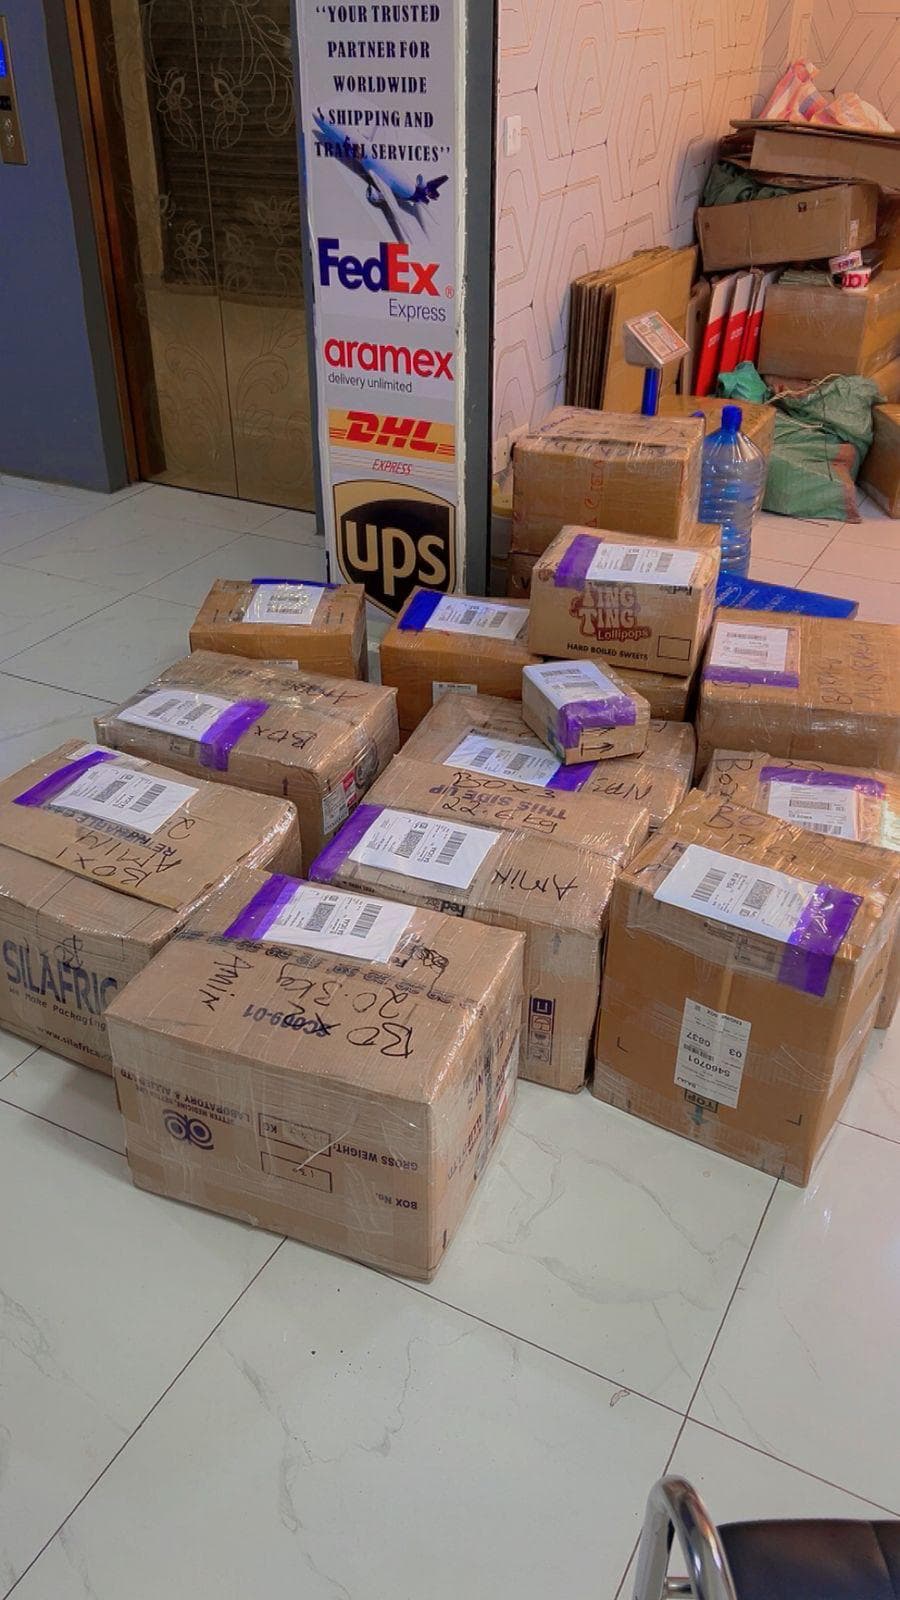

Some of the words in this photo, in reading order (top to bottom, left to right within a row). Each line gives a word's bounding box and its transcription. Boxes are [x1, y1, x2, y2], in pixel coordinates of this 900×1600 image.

[371, 5, 441, 23] TRUSTED
[327, 41, 397, 59] PARTNER
[399, 41, 431, 59] FOR
[333, 75, 428, 94] WORLDWIDE
[328, 109, 401, 128] SHIPPING
[404, 110, 434, 129] AND
[314, 140, 368, 159] TRAVEL
[317, 237, 441, 297] FedEx
[389, 298, 447, 323] Express
[324, 338, 454, 381] aramex
[328, 371, 366, 389] delivery
[367, 378, 413, 393] unlimited
[346, 411, 438, 453] DHL
[372, 458, 413, 476] EXPRESS
[346, 520, 447, 596] ups
[578, 607, 637, 635] TING
[597, 627, 650, 641] Lollipops
[567, 642, 589, 652] HARD
[591, 645, 618, 657] BOILED
[619, 650, 649, 661] SWEETS
[429, 783, 459, 797] UP
[452, 771, 530, 794] BOX
[536, 789, 556, 799] 3
[462, 789, 514, 807] SIDE
[517, 801, 567, 820] THIS
[74, 852, 153, 889] BOX
[491, 868, 579, 901] AMIN
[199, 952, 255, 1012] AMIN
[25, 993, 48, 1009] Make
[53, 1004, 107, 1032] Packaging
[686, 1031, 711, 1048] 0837
[728, 1048, 743, 1059] 03
[688, 1055, 731, 1078] 5460701
[184, 1094, 250, 1122] LABORATORY
[687, 1094, 715, 1109] TOP
[331, 1141, 379, 1164] WEIGHT:
[381, 1155, 418, 1171] GROSS
[395, 1198, 418, 1210] BOX
